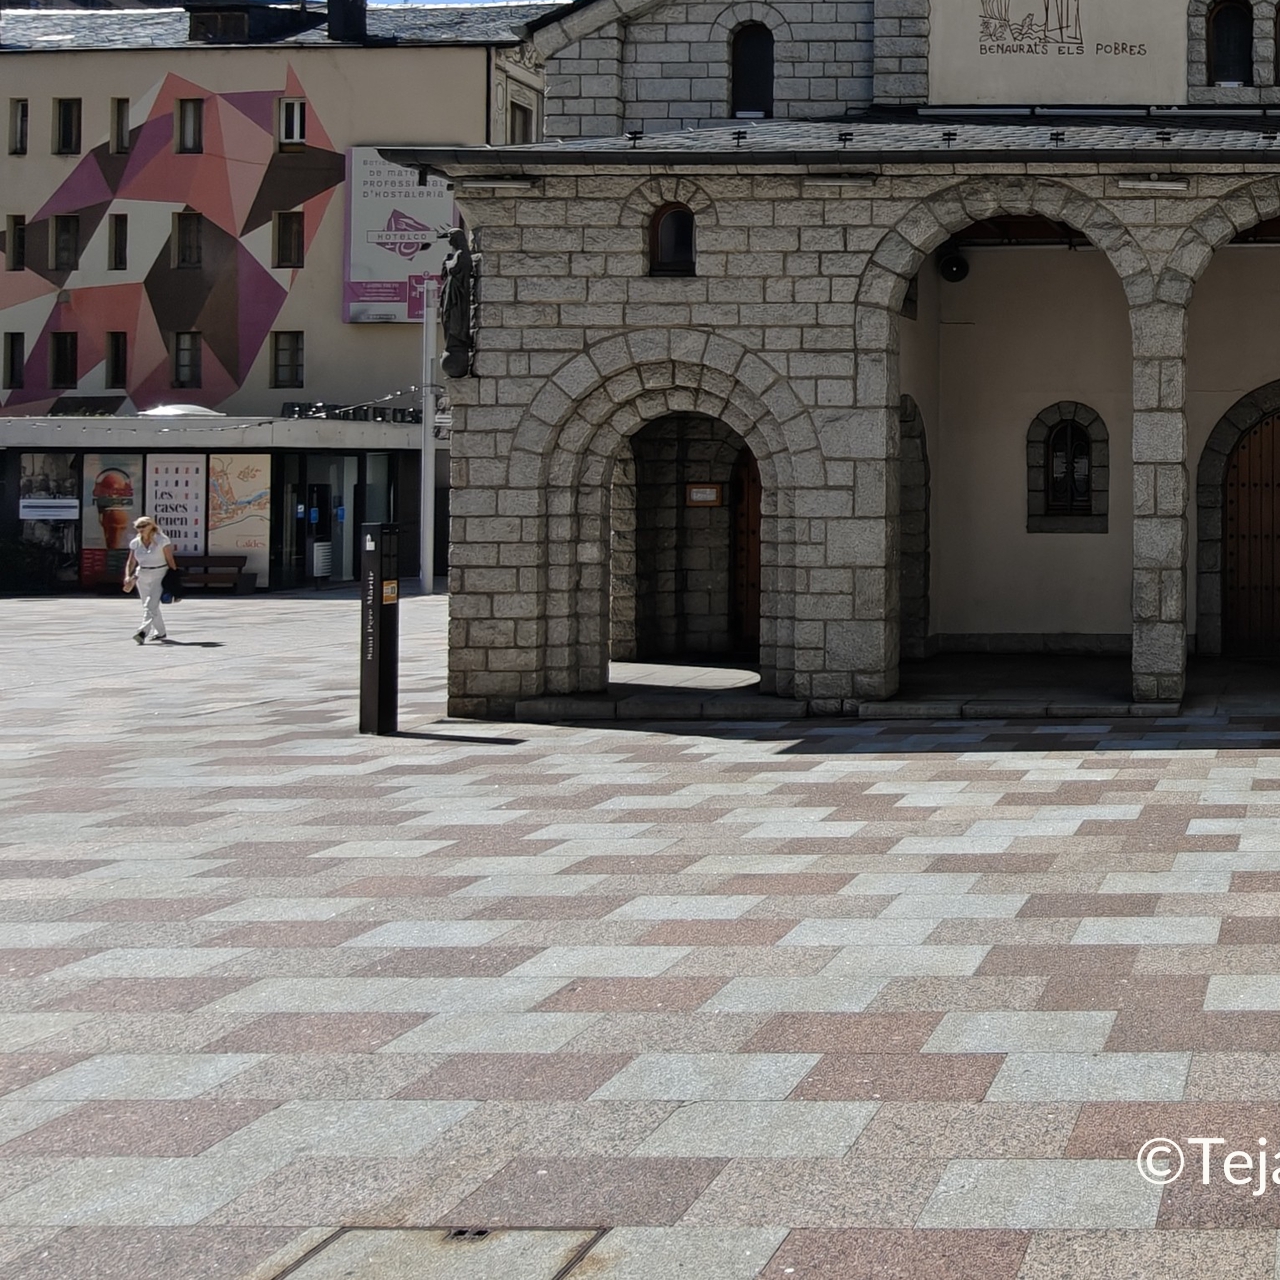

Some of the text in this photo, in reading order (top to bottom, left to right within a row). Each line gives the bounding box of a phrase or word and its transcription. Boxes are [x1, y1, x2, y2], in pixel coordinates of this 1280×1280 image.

[979, 42, 1147, 56] BENAURATS ELS POBRES
